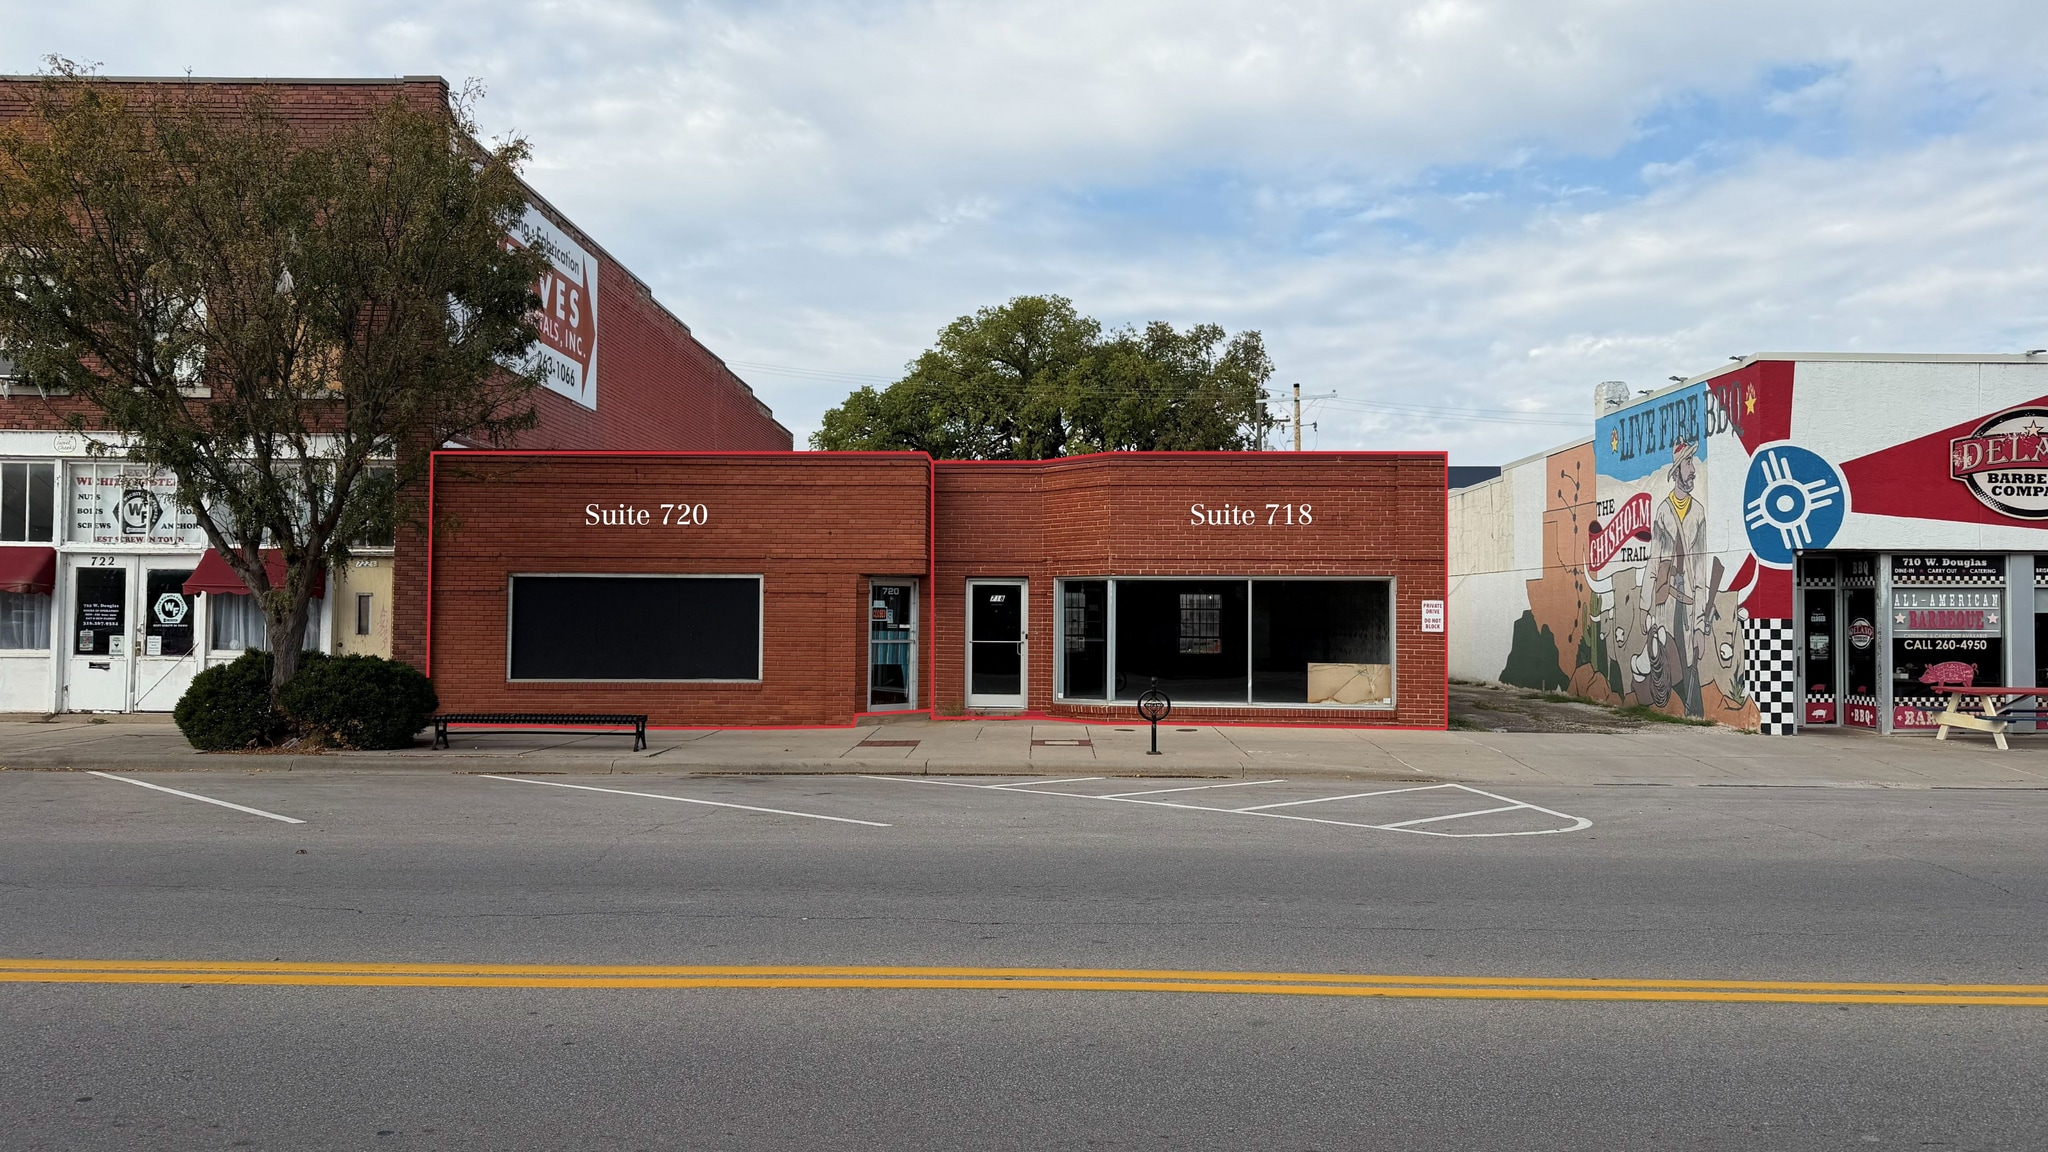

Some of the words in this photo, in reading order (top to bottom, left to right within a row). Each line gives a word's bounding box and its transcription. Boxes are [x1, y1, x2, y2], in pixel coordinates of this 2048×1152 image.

[537, 225, 580, 276] Fabrication
[565, 329, 586, 358] INC.
[1620, 408, 1656, 461] LIVE
[1659, 393, 1700, 450] FIRE
[1703, 381, 1744, 439] BBQ
[1987, 473, 2047, 484] BARBE
[1597, 499, 1615, 517] THE
[1590, 498, 1650, 568] CHISHOLM
[91, 556, 115, 566] 722
[1621, 546, 1648, 563] TRAIL
[1852, 561, 1869, 576] BBQ
[1902, 558, 1921, 566] 710
[1925, 558, 1939, 566] W.
[1942, 558, 1987, 568] Douglas
[882, 587, 900, 596] 720
[1894, 593, 1998, 607] ALL-AMERICAN
[1908, 610, 1984, 630] BARBEQUE
[1904, 640, 1933, 650] CALL
[1935, 640, 1987, 650] 260-4950
[1854, 709, 1871, 725] BBQ
